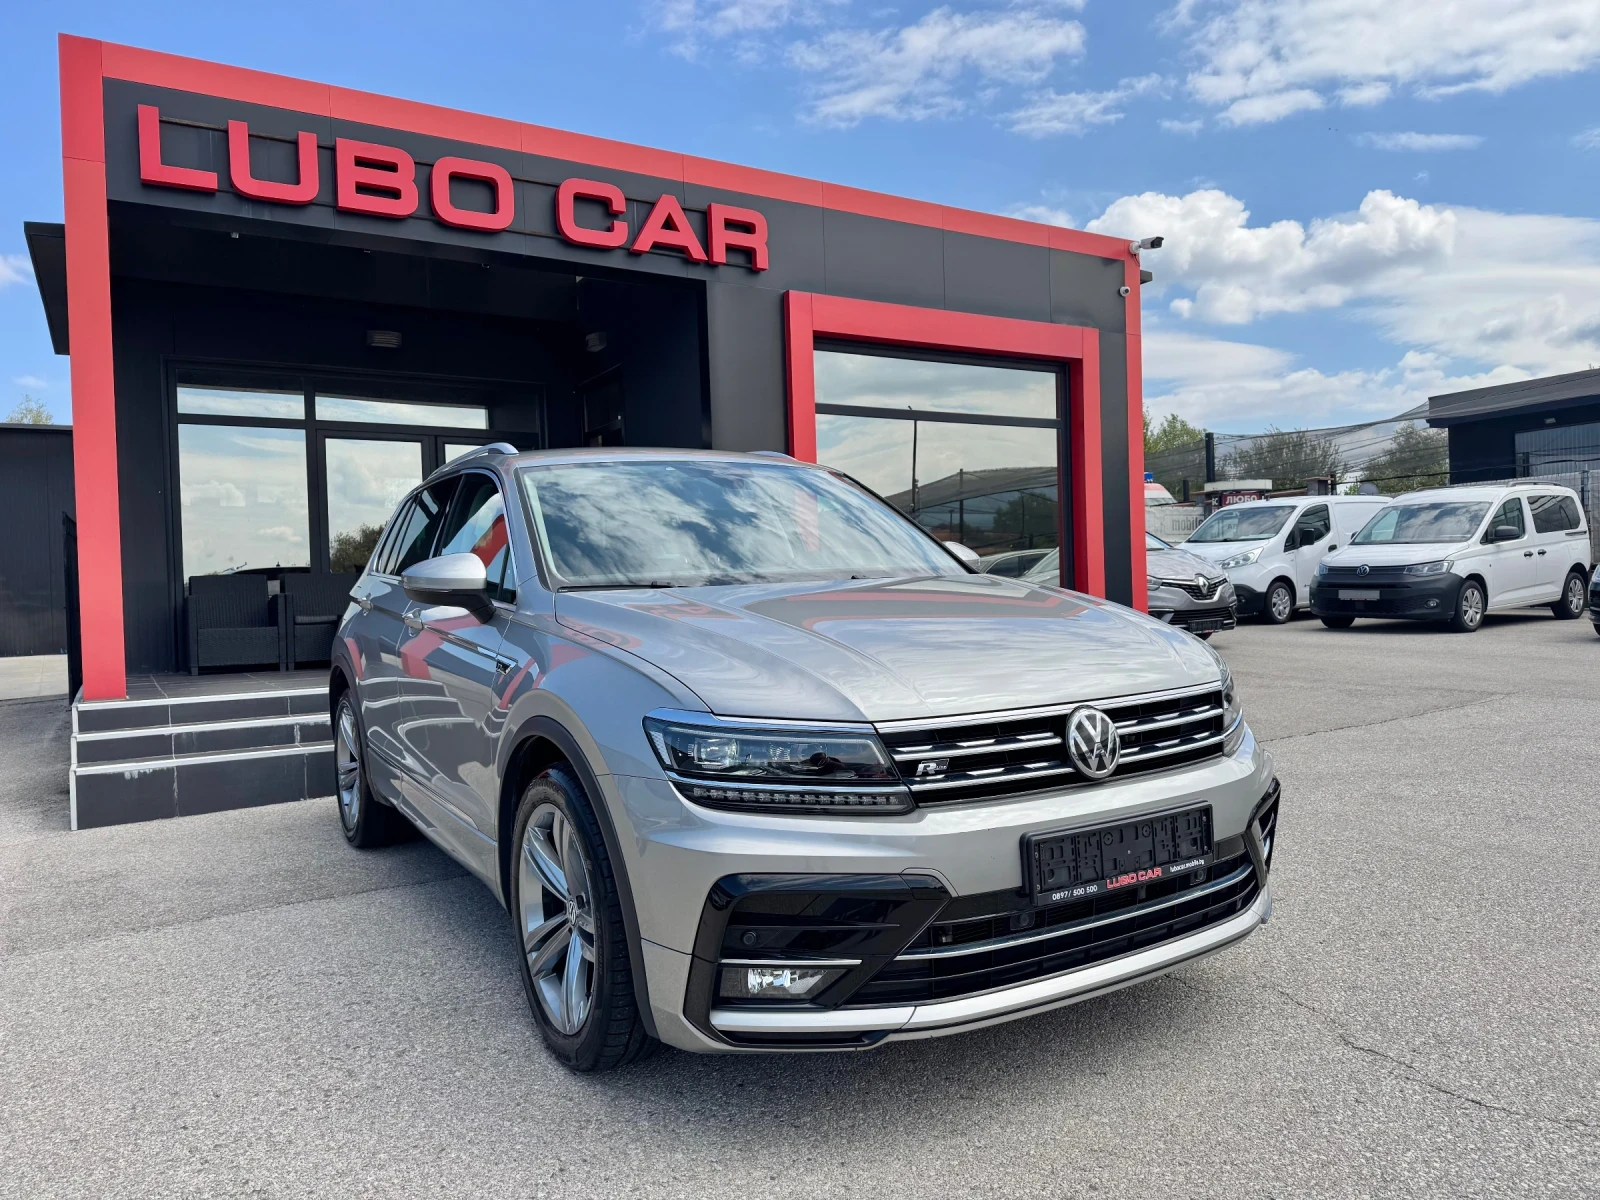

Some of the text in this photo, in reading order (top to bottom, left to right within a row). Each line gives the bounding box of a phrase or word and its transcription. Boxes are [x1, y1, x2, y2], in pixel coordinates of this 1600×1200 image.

[137, 104, 769, 271] LUBO CAR
[1106, 867, 1162, 889] LUBO CAR
[1052, 885, 1098, 901] 0897/ 500 500
